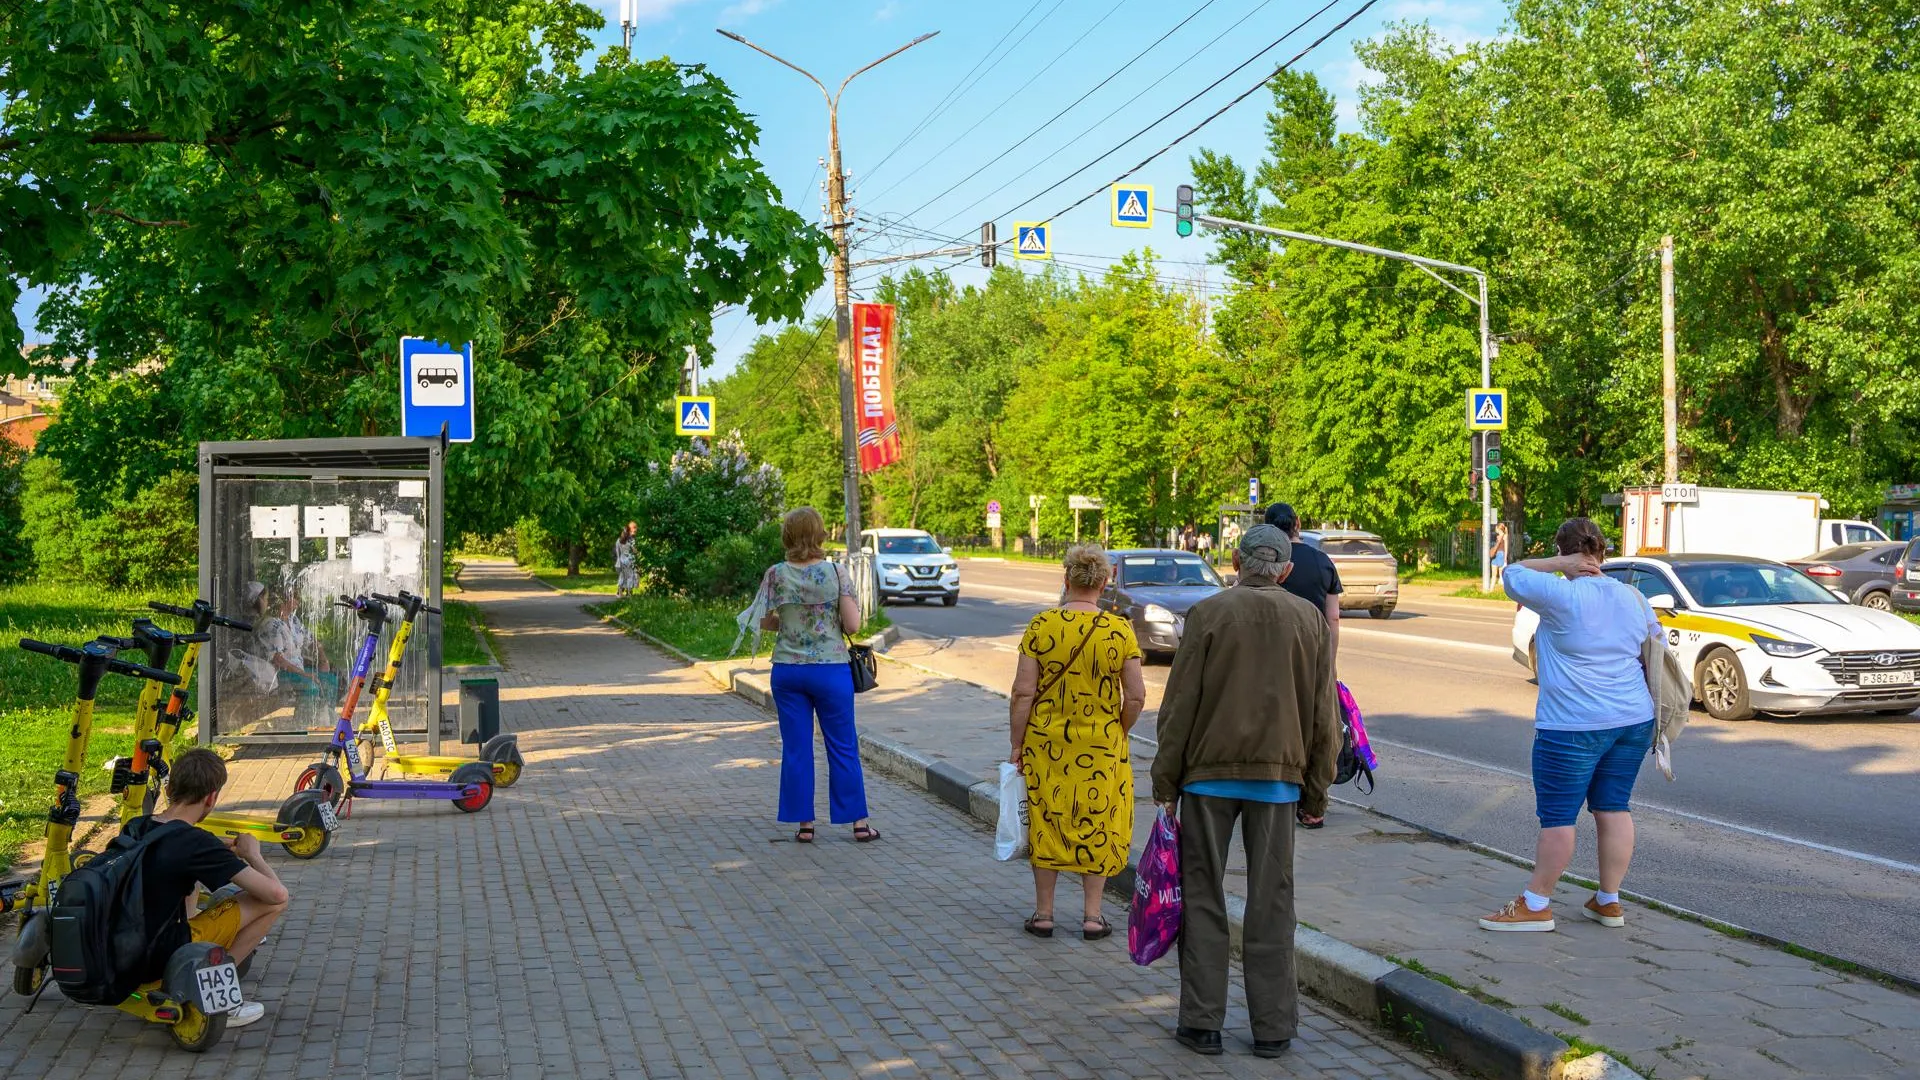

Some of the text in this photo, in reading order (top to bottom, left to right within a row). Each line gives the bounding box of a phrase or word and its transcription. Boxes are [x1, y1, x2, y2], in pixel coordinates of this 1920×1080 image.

[862, 327, 884, 417] ПОБЕДА!
[1664, 487, 1696, 498] СТОП
[1669, 630, 1680, 645] Go
[348, 743, 360, 764] 4759
[198, 967, 235, 990] НА9
[205, 987, 241, 1010] 13С
